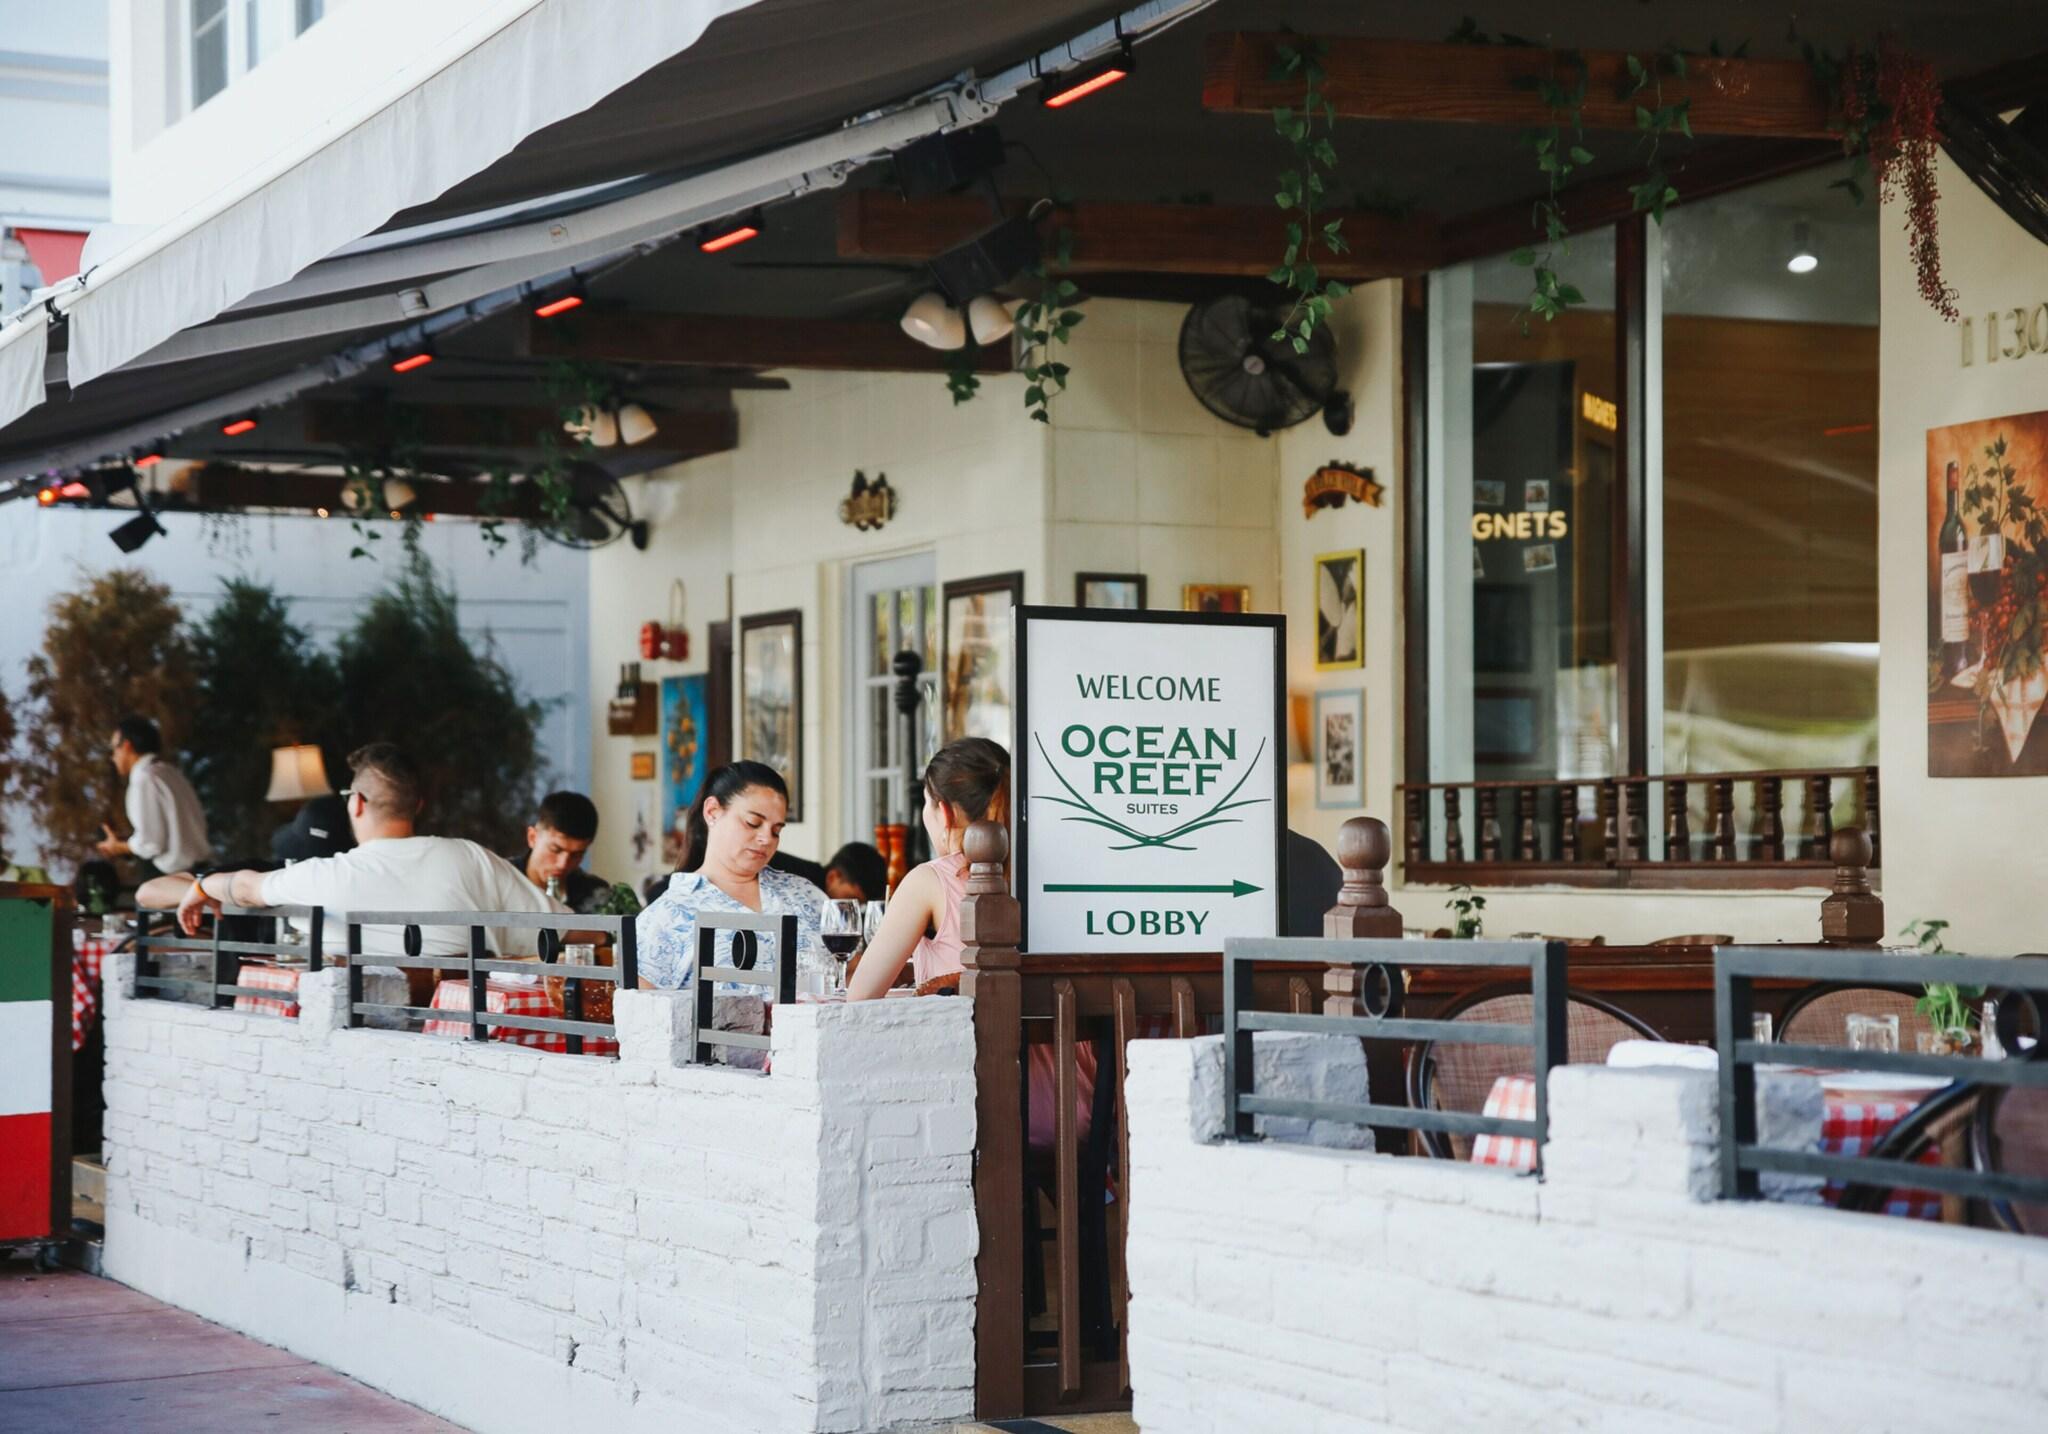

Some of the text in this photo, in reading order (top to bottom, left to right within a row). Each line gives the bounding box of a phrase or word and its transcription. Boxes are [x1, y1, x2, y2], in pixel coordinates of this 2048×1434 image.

[1076, 674, 1222, 702] WELCOME
[1061, 724, 1238, 760] OCEAN
[1093, 761, 1223, 796] REEF
[1126, 803, 1179, 815] SUITES
[1086, 910, 1210, 936] LOBBY
